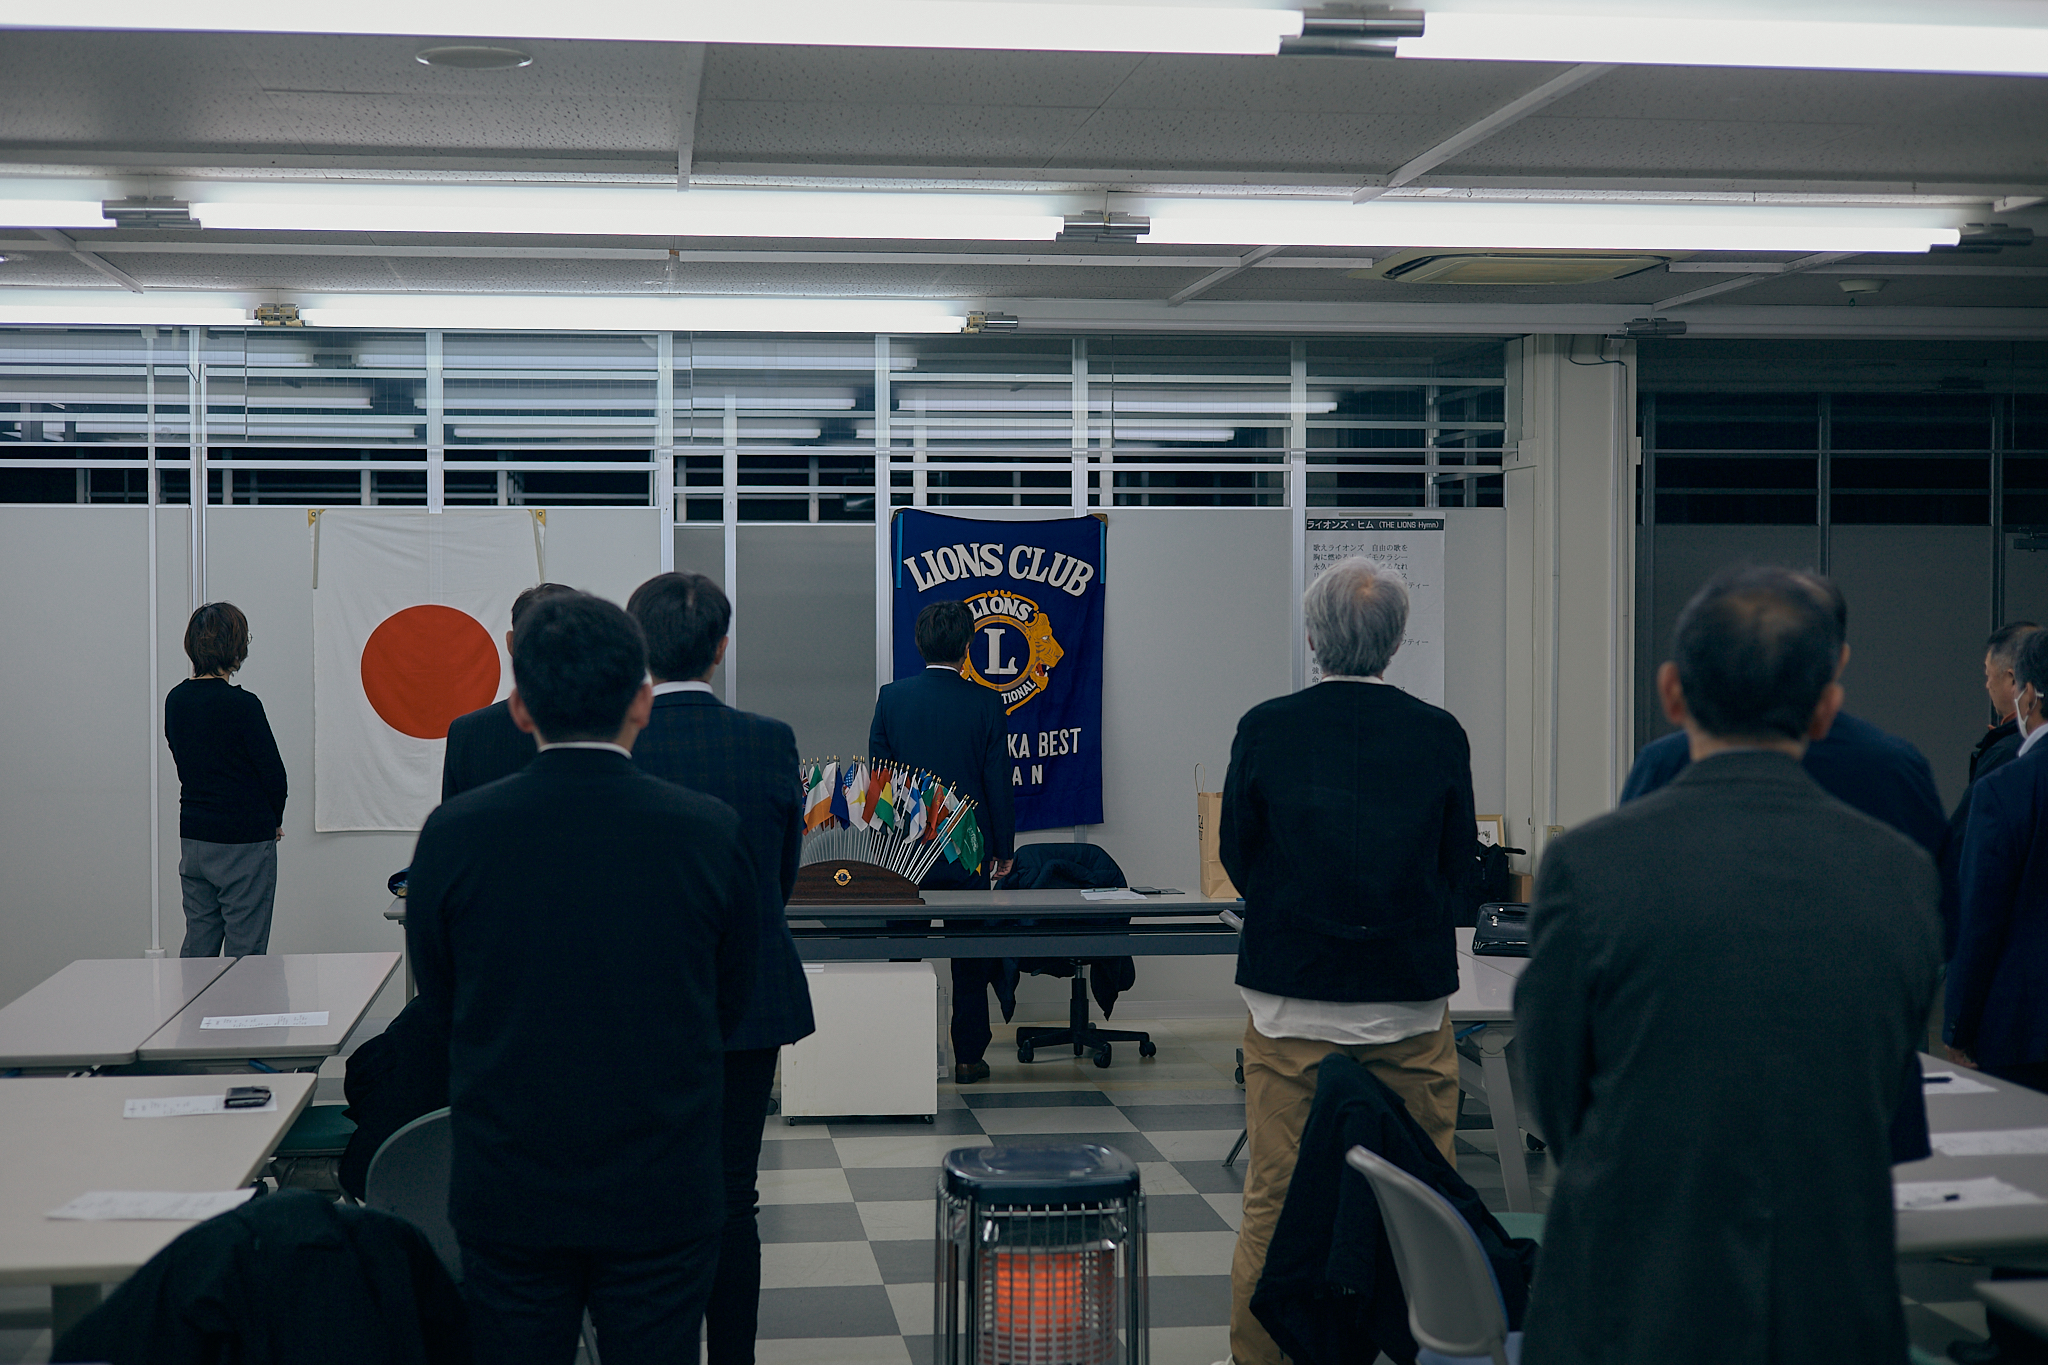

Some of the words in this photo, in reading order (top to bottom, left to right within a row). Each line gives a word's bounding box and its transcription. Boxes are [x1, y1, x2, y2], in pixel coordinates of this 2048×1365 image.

[1306, 520, 1374, 530] ライオンズ・ヒム
[1396, 521, 1417, 529] LIONS
[1312, 543, 1365, 552] 歌えライオンズ
[1371, 543, 1408, 552] 自由の歌を
[903, 543, 1004, 593] LIONS
[1008, 544, 1095, 597] CLUB
[967, 596, 1033, 622] LIONS
[983, 628, 1019, 675] L
[1001, 680, 1037, 705] TIONAL
[1007, 733, 1031, 759] KA
[1038, 727, 1082, 758] BEST
[1012, 764, 1043, 787] AN
